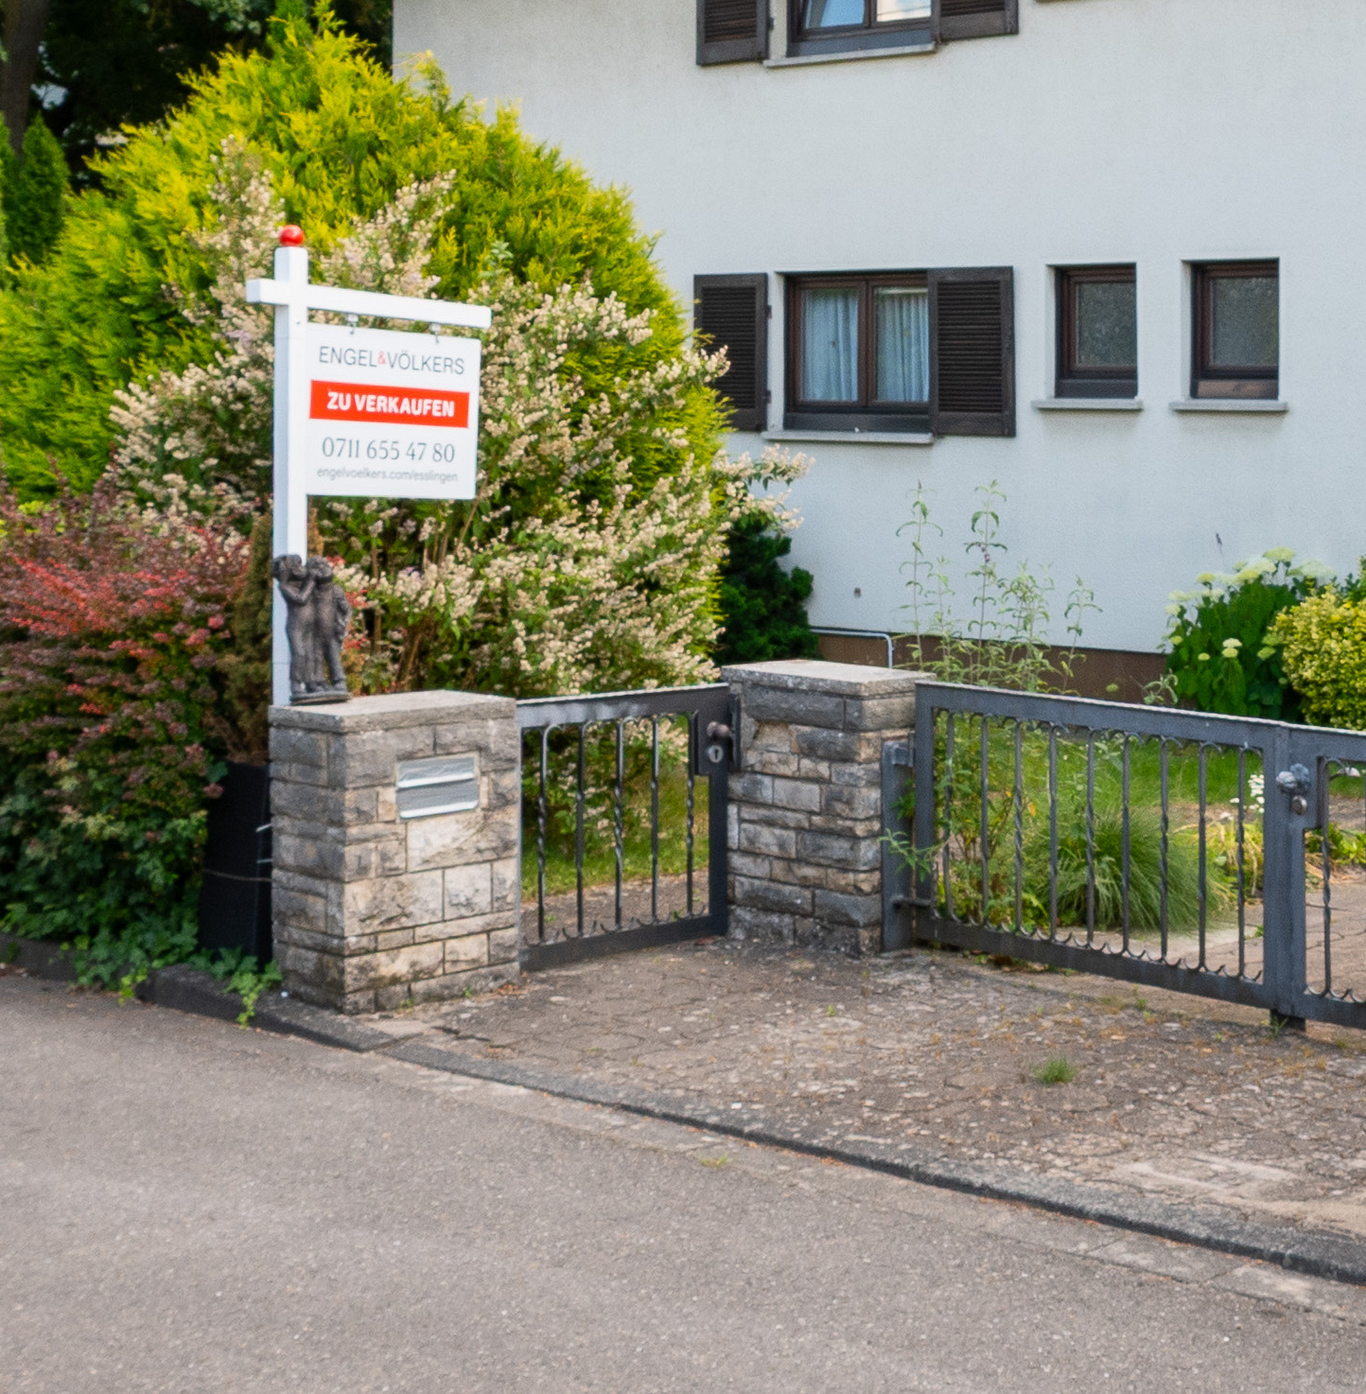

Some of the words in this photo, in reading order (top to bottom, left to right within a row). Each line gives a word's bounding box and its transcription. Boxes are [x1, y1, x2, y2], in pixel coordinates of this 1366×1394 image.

[318, 346, 465, 375] ENGEL&VÖLKERS
[327, 391, 351, 411] ZU
[354, 394, 455, 417] VERKAUFEN
[322, 437, 360, 458] 0711
[366, 440, 400, 460] 655
[406, 442, 427, 461] 47
[432, 443, 455, 463] 80
